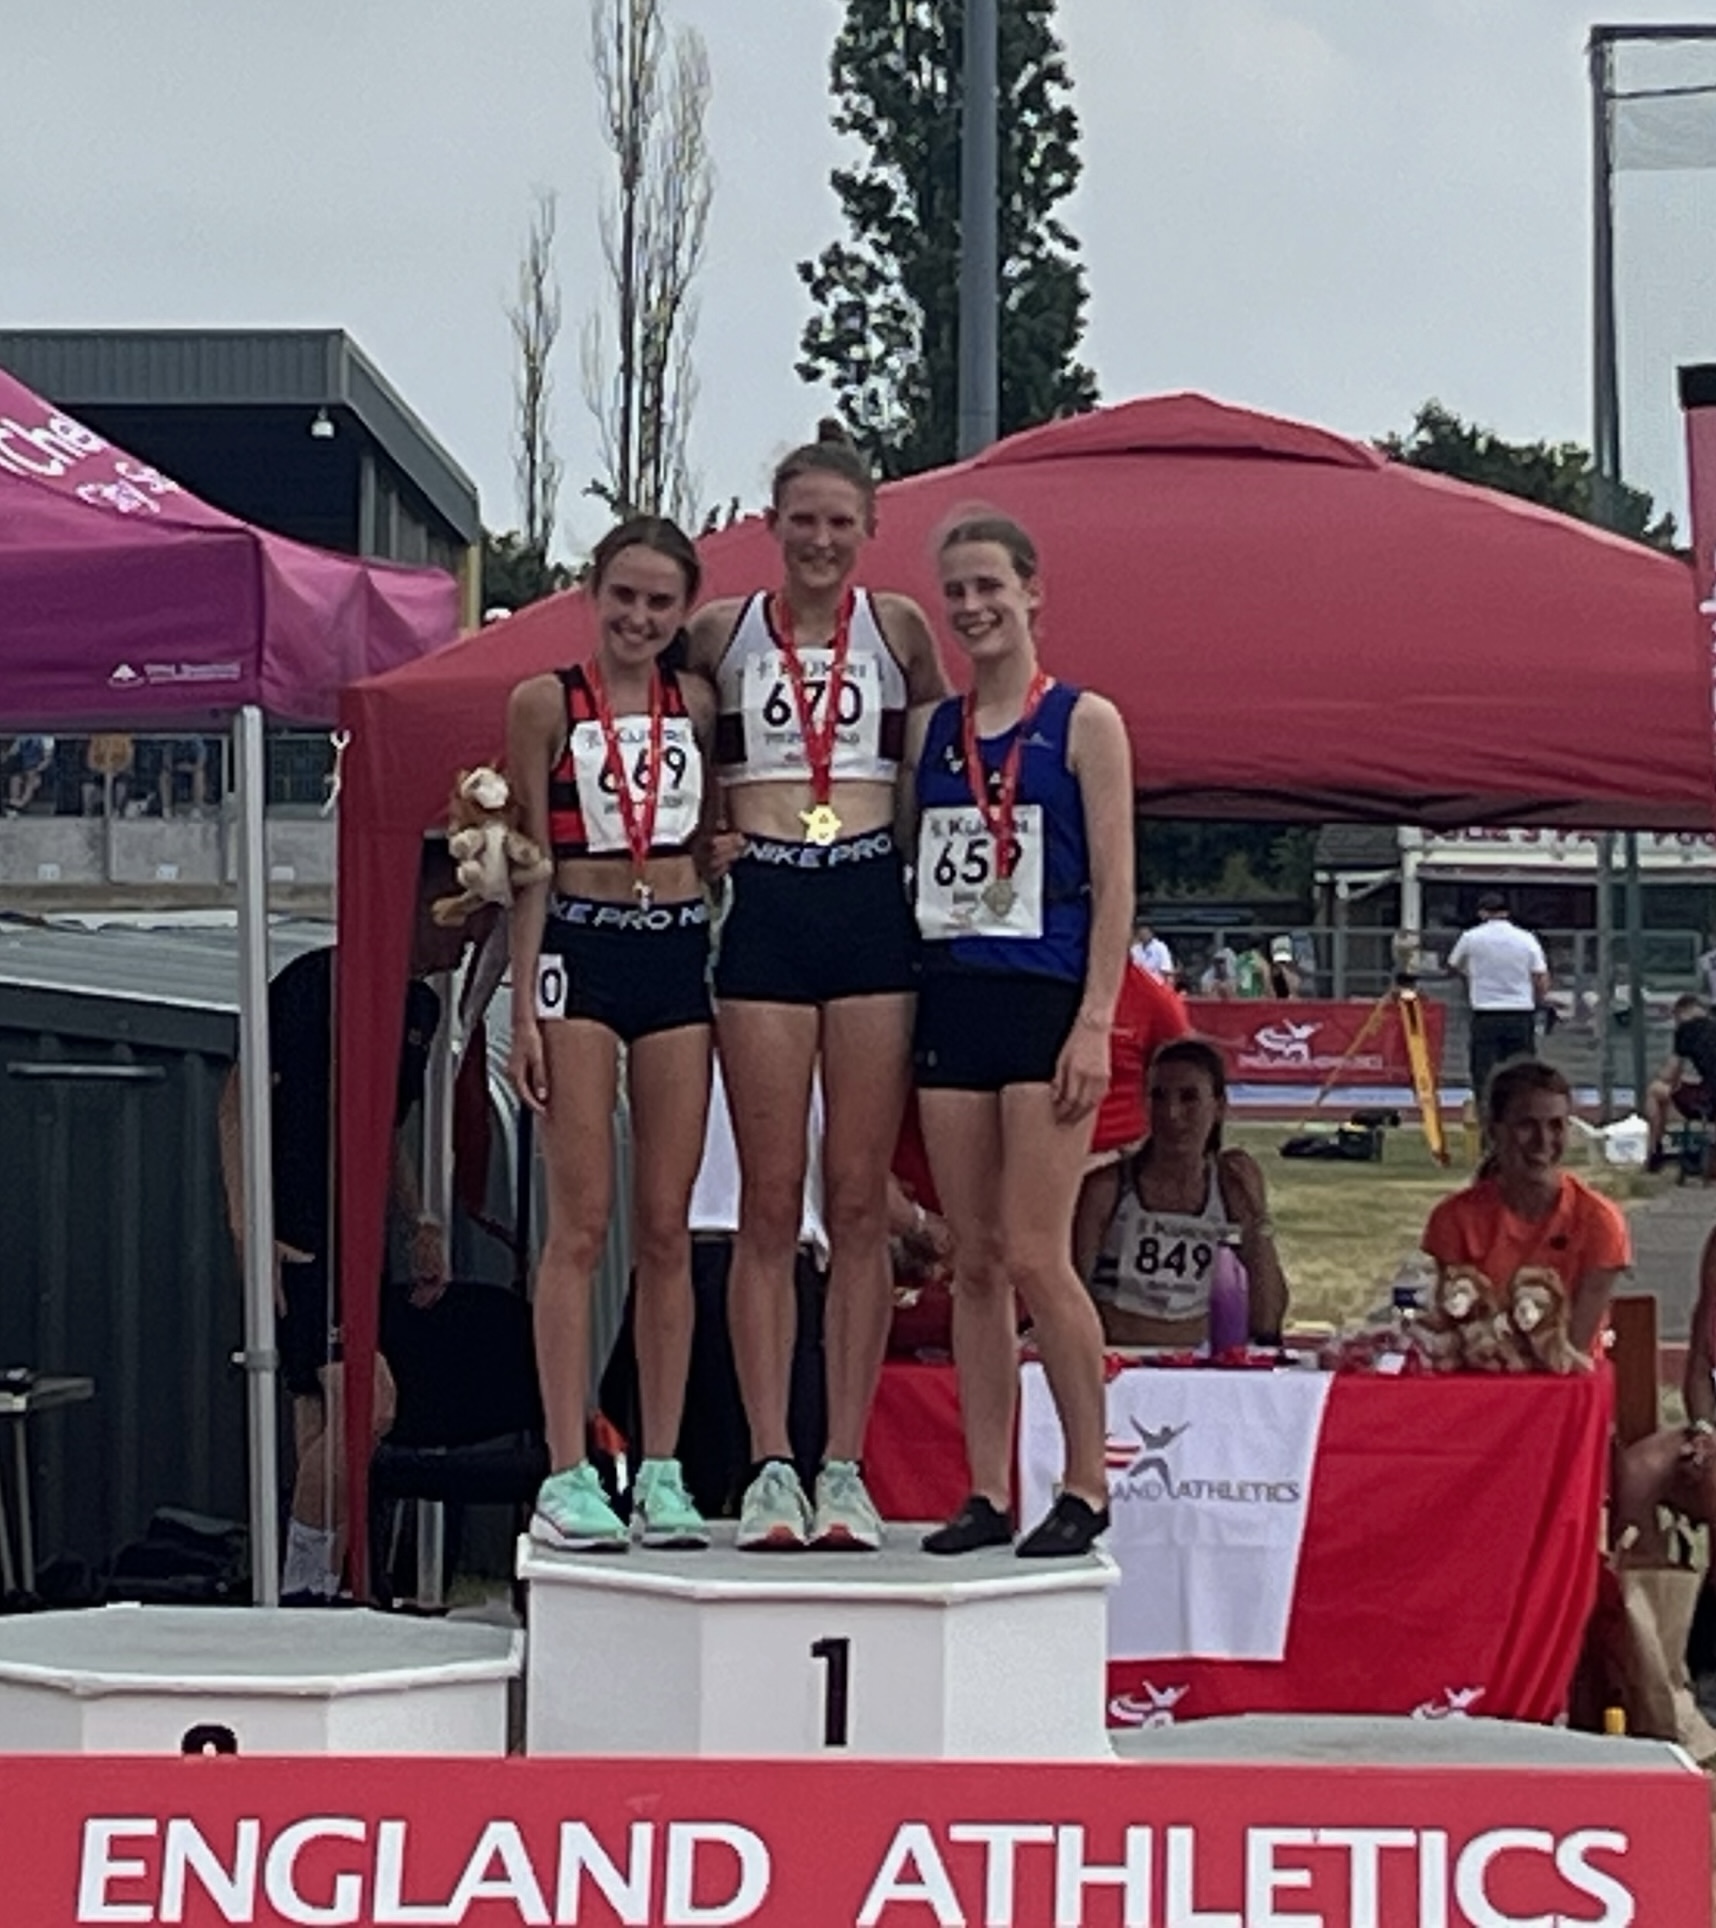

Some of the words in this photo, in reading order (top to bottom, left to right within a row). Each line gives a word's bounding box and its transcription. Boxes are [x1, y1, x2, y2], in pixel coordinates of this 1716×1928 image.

[762, 680, 863, 726] 670
[598, 746, 686, 795] 669
[743, 839, 825, 868] NIKE
[828, 833, 891, 867] PRO
[551, 893, 593, 924] KE
[592, 905, 673, 931] PRO
[1135, 1237, 1213, 1281] 849
[1177, 1479, 1301, 1503] ATHLETICS
[810, 1637, 850, 1746] 1
[76, 1817, 772, 1927] ENGLAND
[855, 1822, 1636, 1928] ATHLETICS
